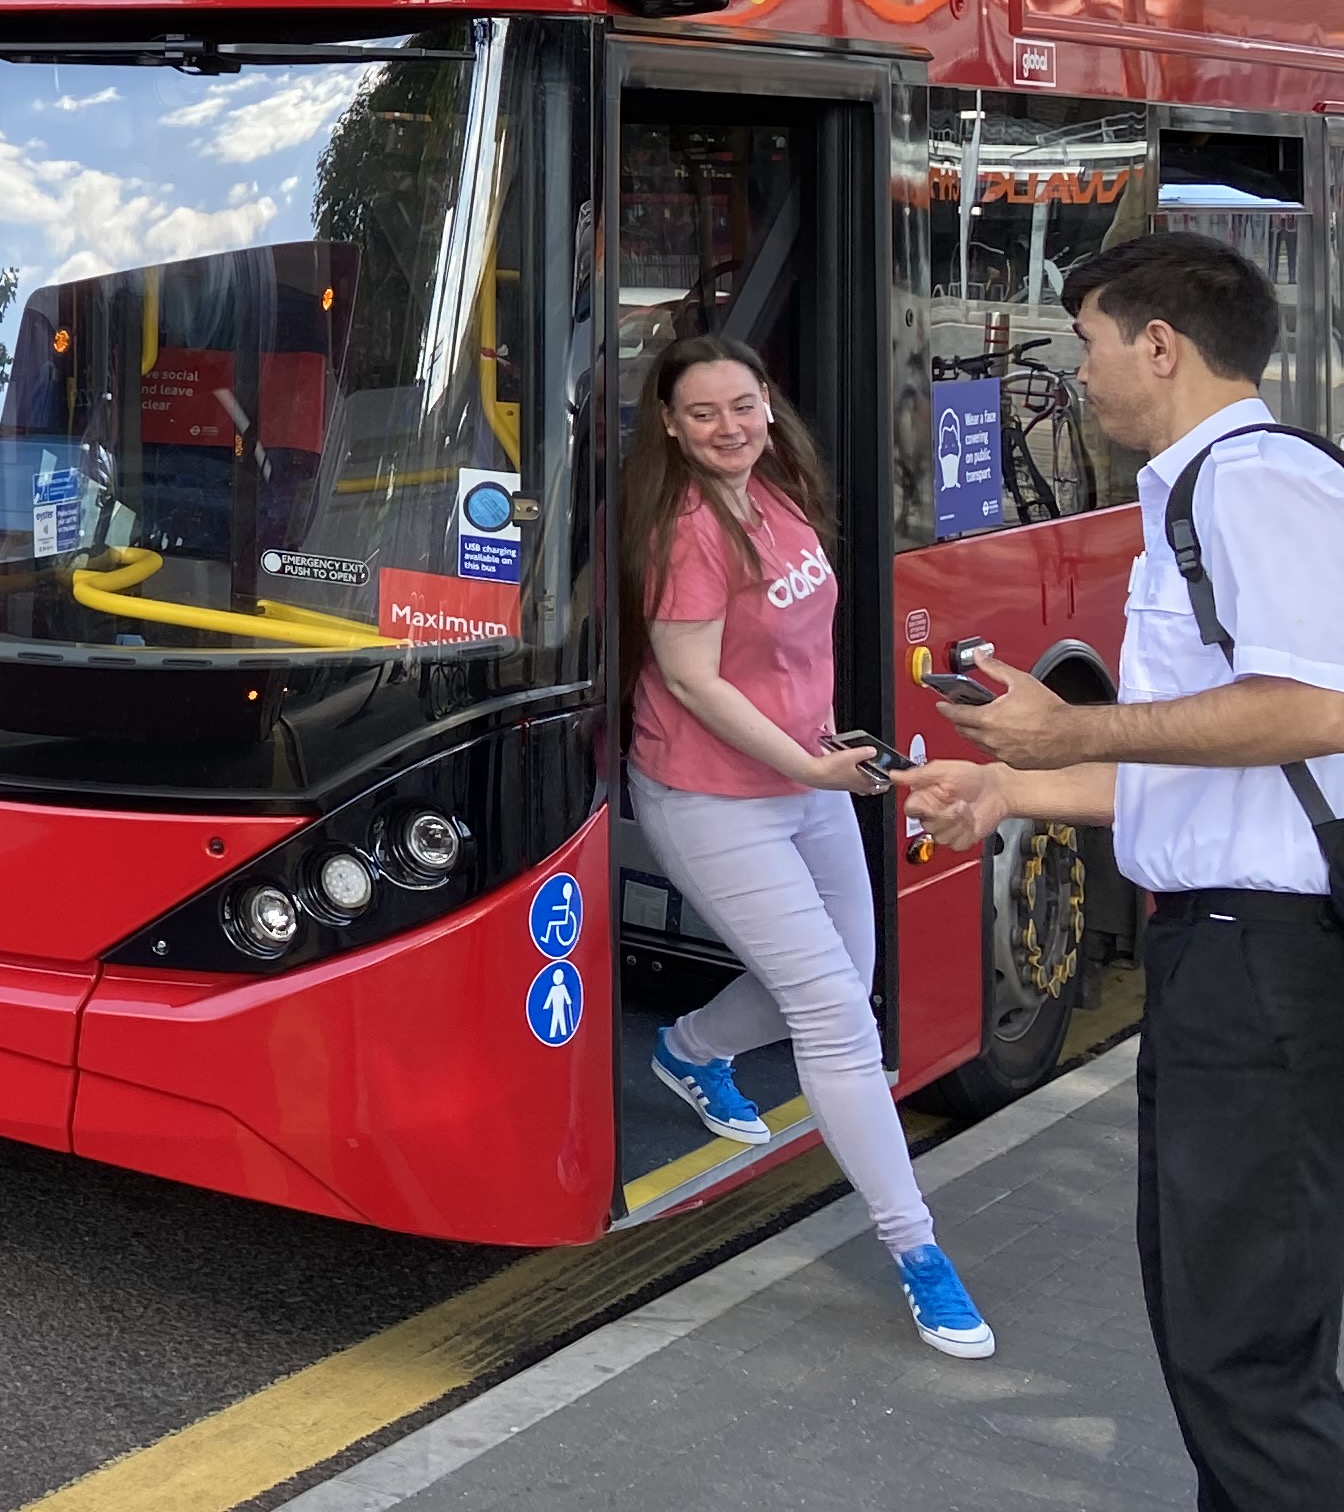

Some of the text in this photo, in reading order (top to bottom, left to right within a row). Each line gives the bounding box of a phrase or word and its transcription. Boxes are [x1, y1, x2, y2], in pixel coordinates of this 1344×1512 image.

[1022, 47, 1048, 78] global
[162, 370, 199, 381] social
[160, 384, 194, 397] leave
[141, 399, 172, 410] clear
[964, 411, 980, 426] Wear
[984, 409, 997, 424] face
[965, 430, 989, 445] covering
[973, 447, 991, 466] public
[965, 467, 992, 483] transport
[464, 542, 517, 557] USB charging
[281, 554, 364, 573] EMERGENCY EXIT
[464, 553, 513, 565] available on
[464, 561, 497, 572] this bus
[284, 565, 357, 583] PUSH TO OPEN
[391, 603, 507, 637] Maximum
